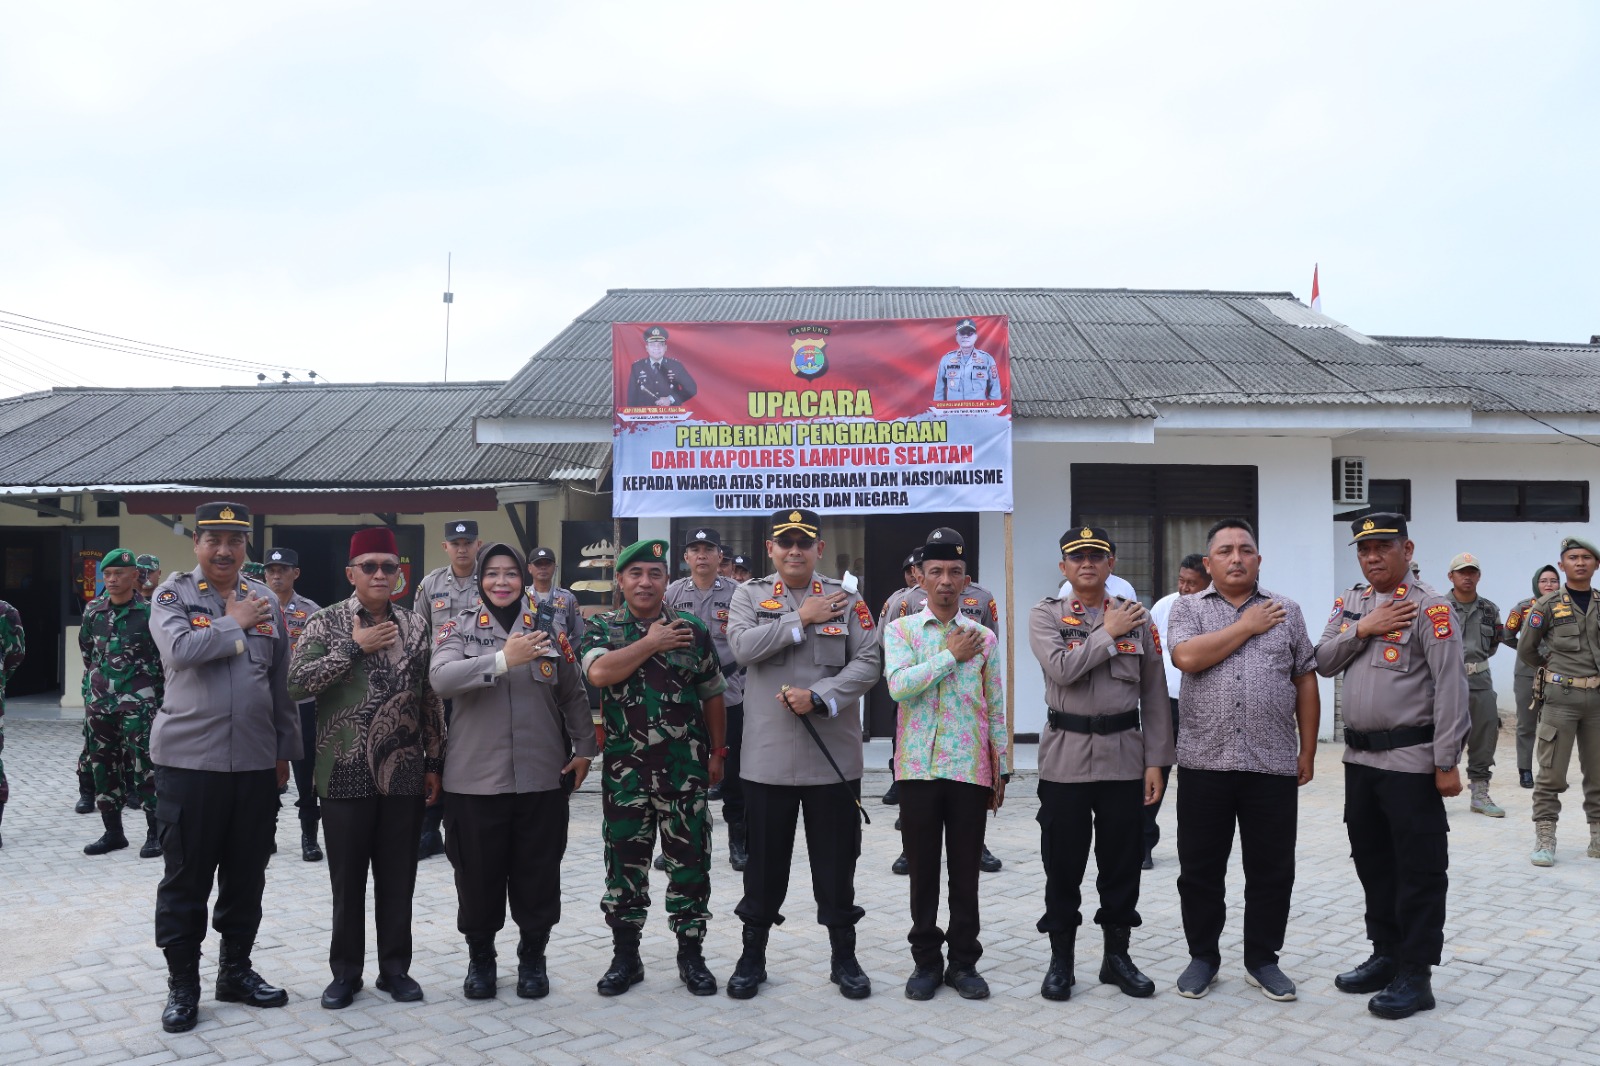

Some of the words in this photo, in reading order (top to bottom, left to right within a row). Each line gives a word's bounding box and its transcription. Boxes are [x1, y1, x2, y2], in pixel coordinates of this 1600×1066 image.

[790, 326, 829, 335] LAMPUNG
[747, 390, 873, 418] UPACARA
[676, 424, 792, 447] PEMBERIAN
[796, 421, 947, 445] PENGHARGAAN
[651, 450, 695, 469] DARI
[701, 449, 795, 468] KAPOLRES
[800, 447, 890, 467] LAMPUNG
[895, 445, 973, 465] SELATAN
[622, 475, 673, 491] KEPADA
[677, 474, 727, 490] WARGA
[729, 474, 763, 489] ATAS
[767, 472, 867, 489] PENGORBANAN
[871, 471, 898, 486] DAN
[902, 469, 1003, 486] NASIONALISME
[715, 494, 761, 509] UNTUK
[765, 493, 820, 508] BANGSA
[824, 492, 852, 508] DAN
[855, 491, 909, 507] NEGARA
[1061, 629, 1088, 638] MARTONO
